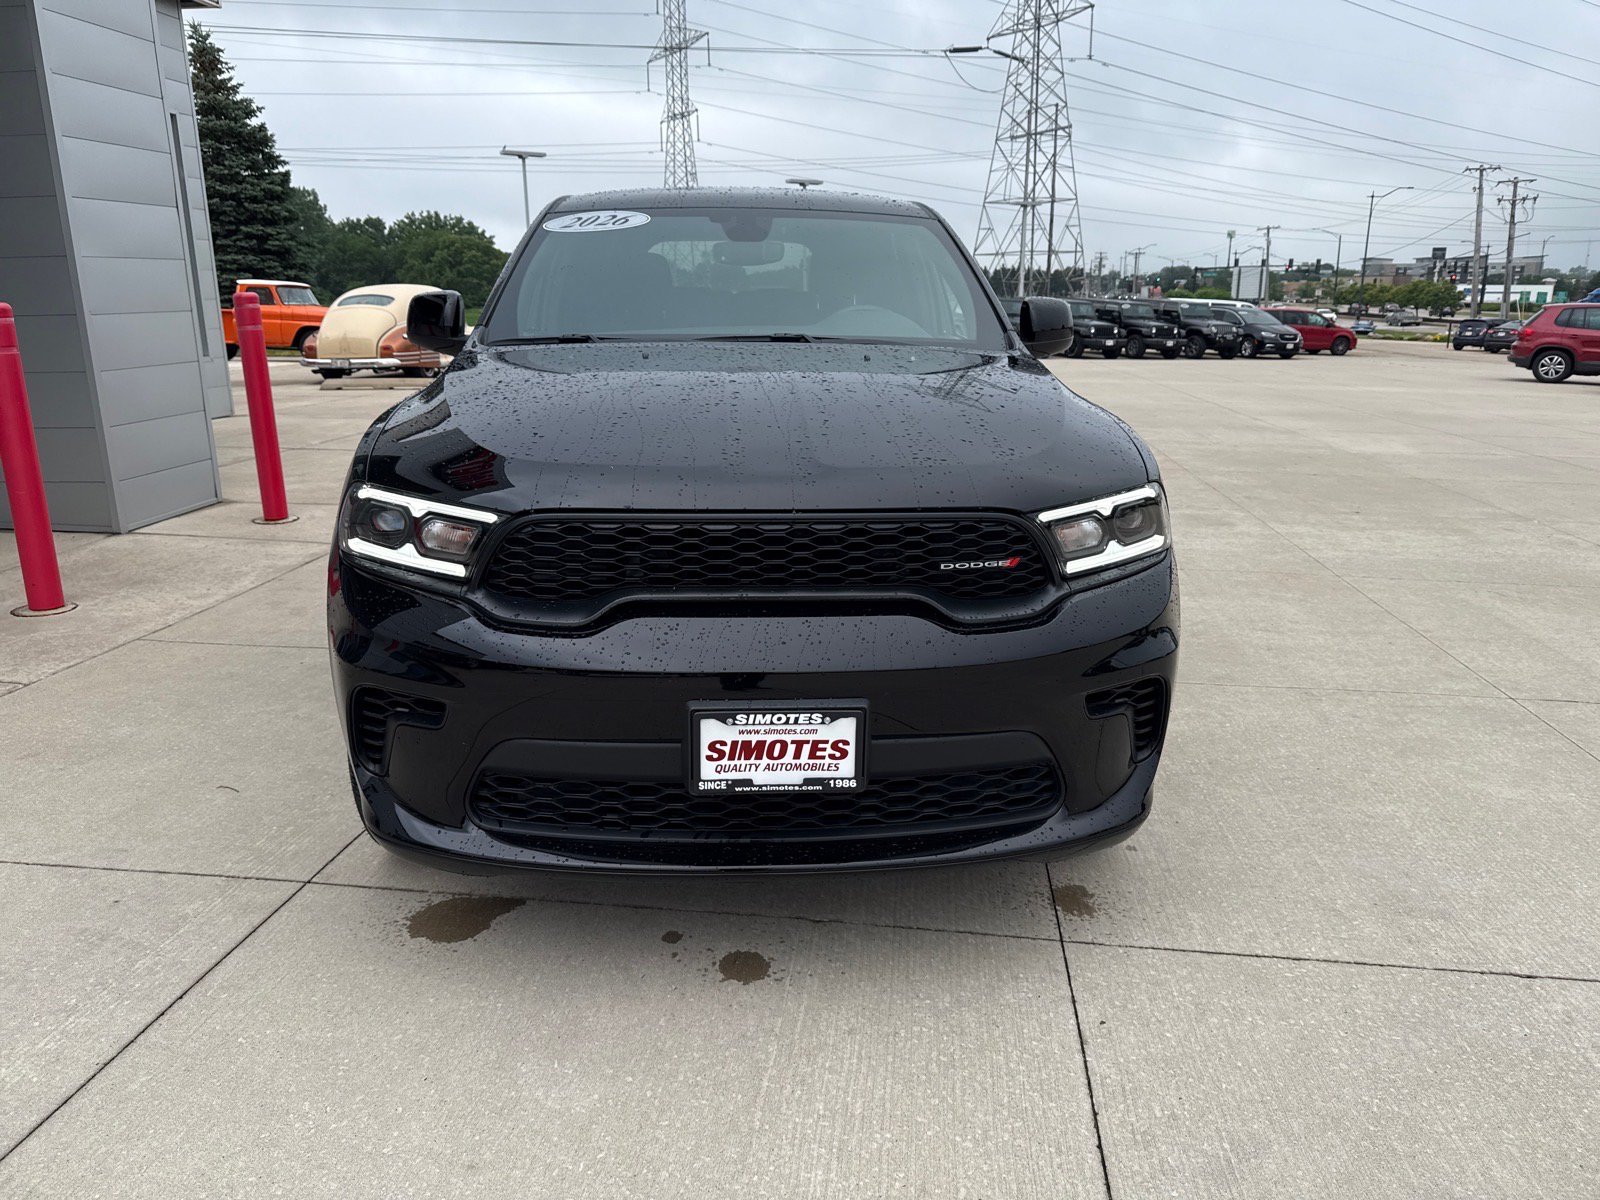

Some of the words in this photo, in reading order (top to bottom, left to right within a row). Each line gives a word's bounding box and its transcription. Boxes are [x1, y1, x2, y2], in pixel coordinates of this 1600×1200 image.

[558, 213, 635, 229] 2026
[940, 560, 1011, 569] DODGE
[735, 713, 823, 725] SIMOTES
[738, 728, 818, 736] www.simotes.com
[705, 739, 851, 762] SIMOTES
[714, 763, 761, 774] QUALITY
[763, 762, 840, 773] AUTOMOBILES
[698, 780, 727, 790] SINCE
[829, 779, 857, 788] 1986
